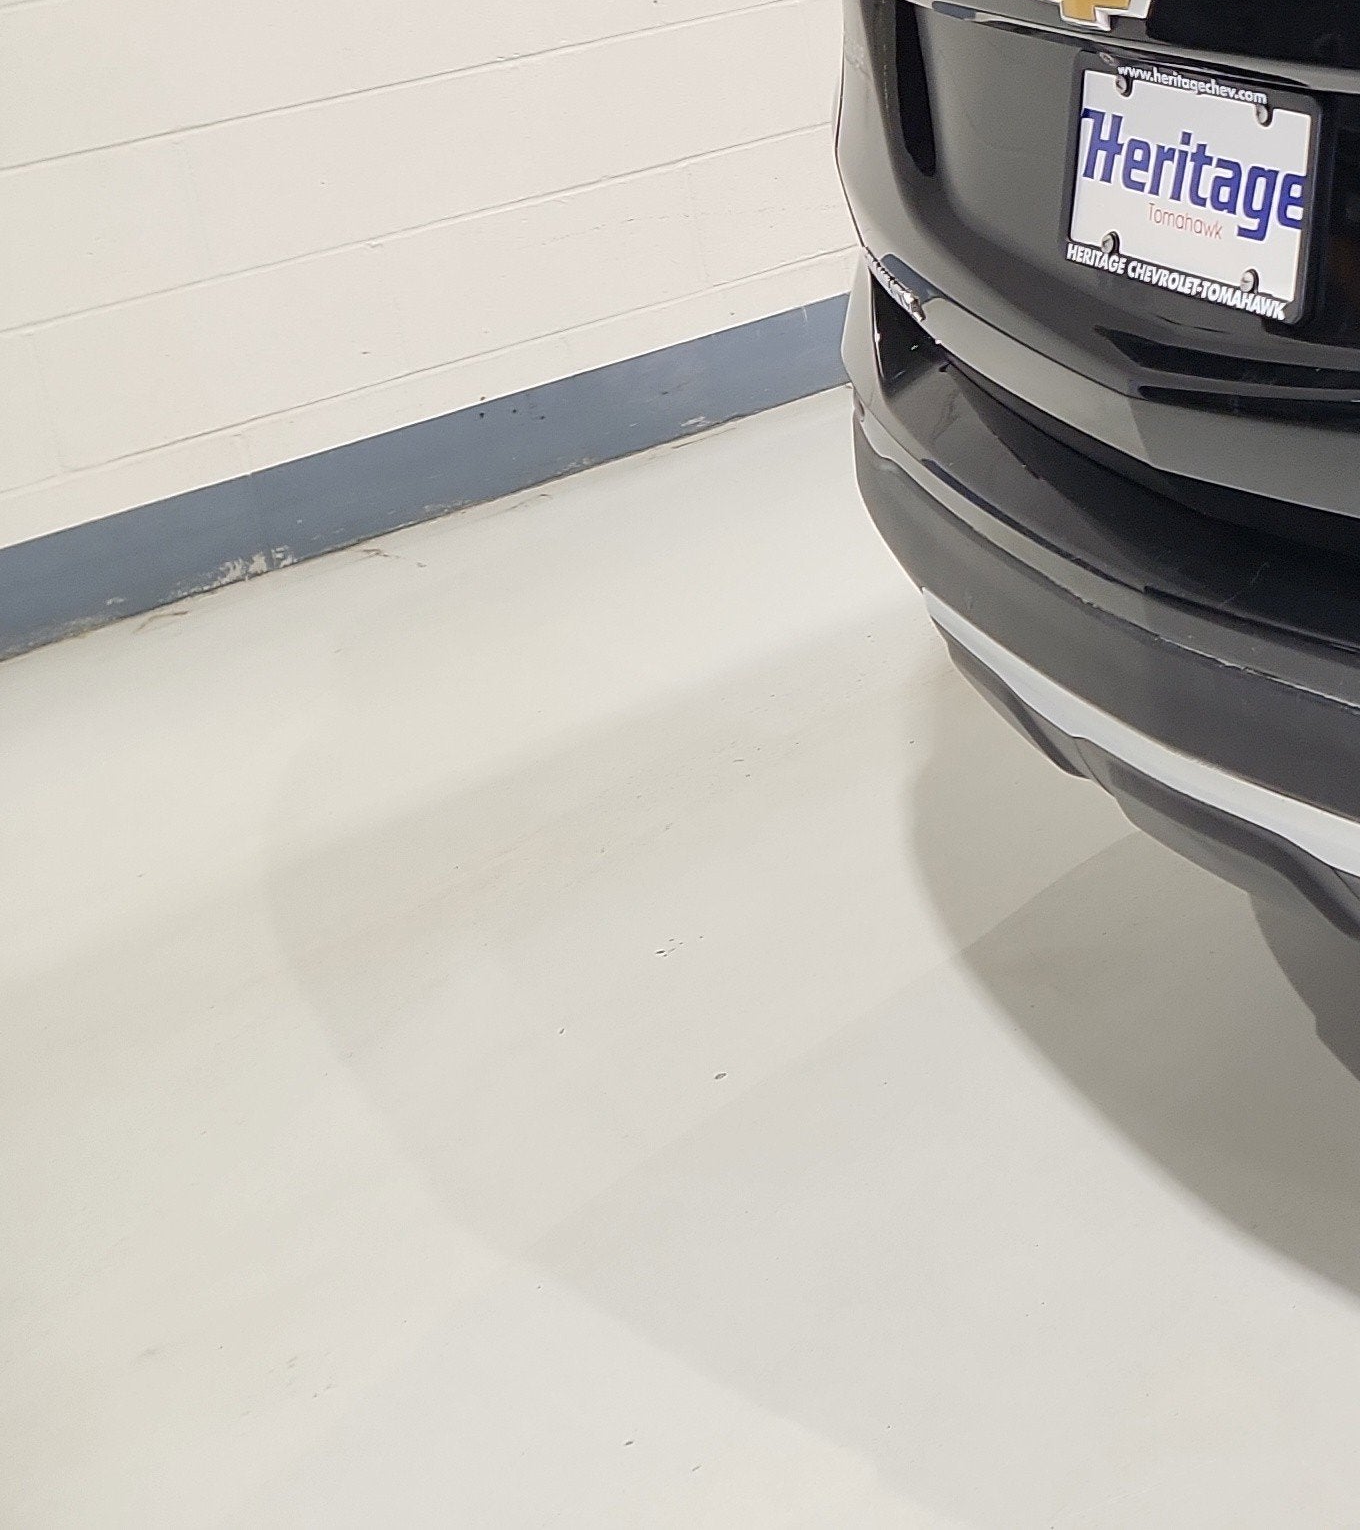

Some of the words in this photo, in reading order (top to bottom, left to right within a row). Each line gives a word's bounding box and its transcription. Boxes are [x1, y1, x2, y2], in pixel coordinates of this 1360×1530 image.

[1116, 66, 1268, 105] www.heritagechev.com
[1080, 107, 1308, 241] Heritage
[1148, 202, 1223, 240] Tomahawk
[1066, 242, 1127, 275] HERITAGE
[1127, 260, 1288, 321] CHEVROLET-TOMAHAWK
